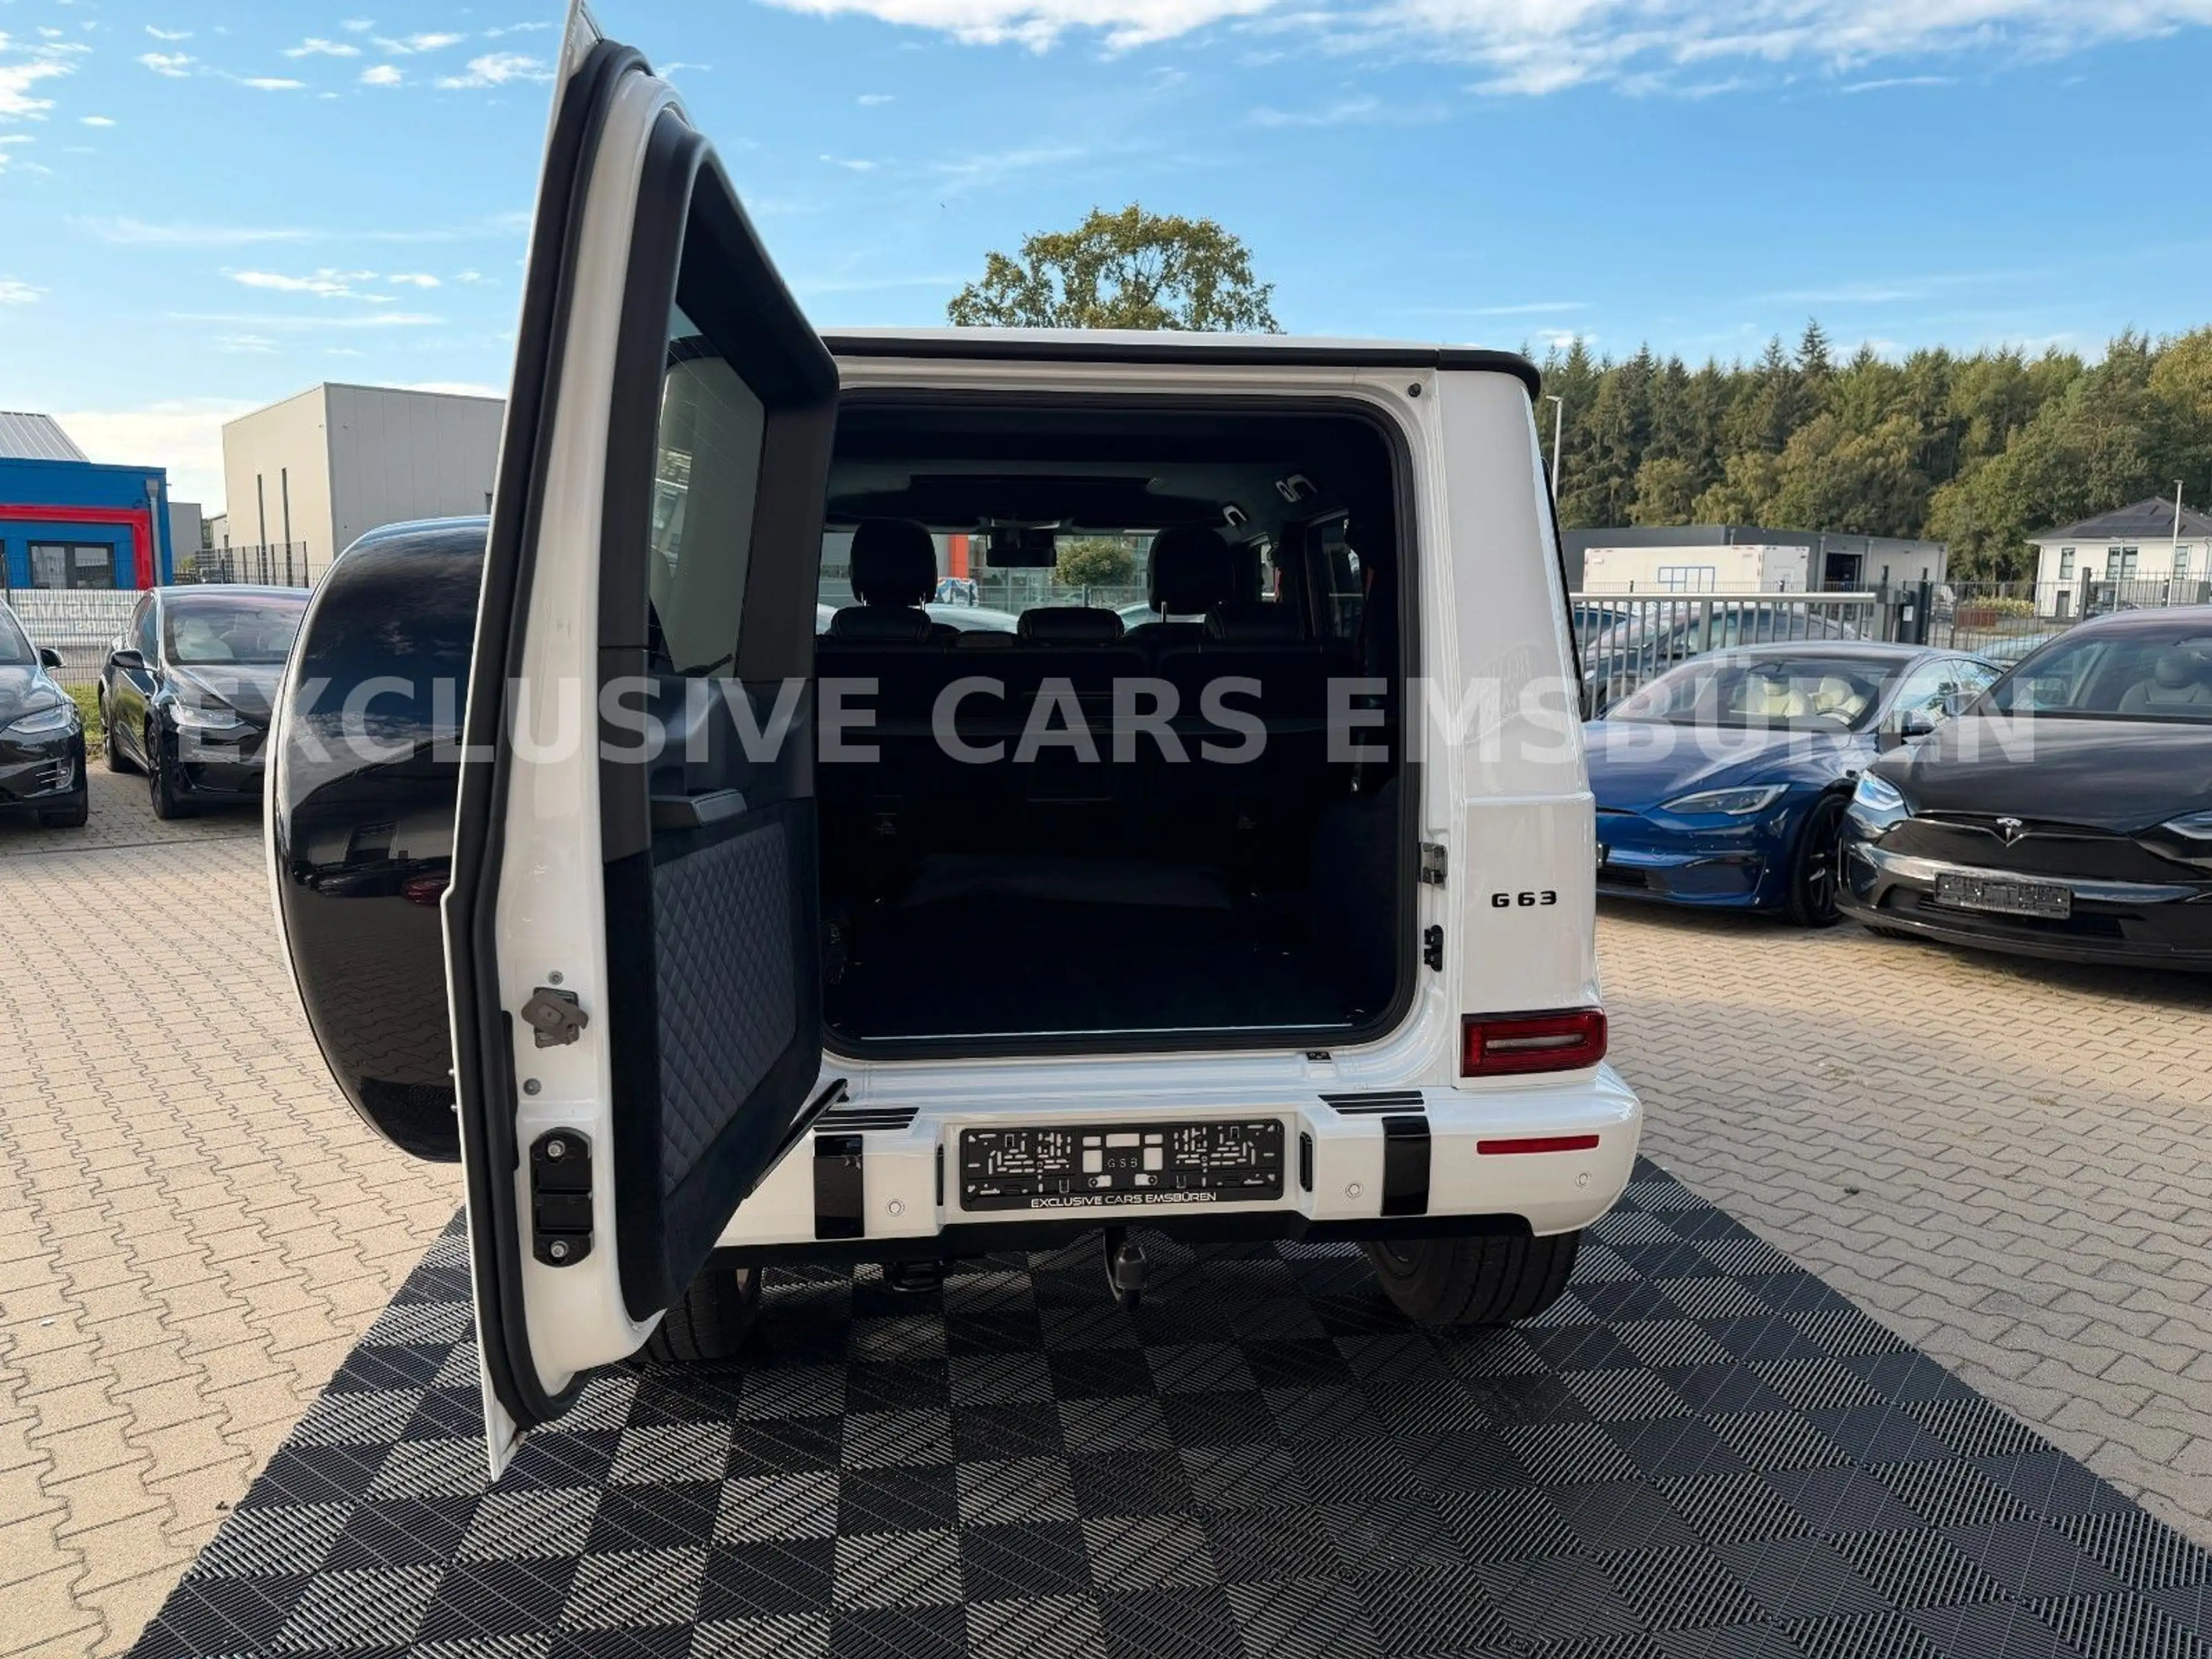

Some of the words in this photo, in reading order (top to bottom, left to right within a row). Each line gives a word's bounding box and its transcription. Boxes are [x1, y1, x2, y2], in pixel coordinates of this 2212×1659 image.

[1031, 1196, 1103, 1208] EXCLUSIVE
[1105, 1194, 1143, 1205] CARS
[1145, 1191, 1217, 1205] EMSBÜREN
